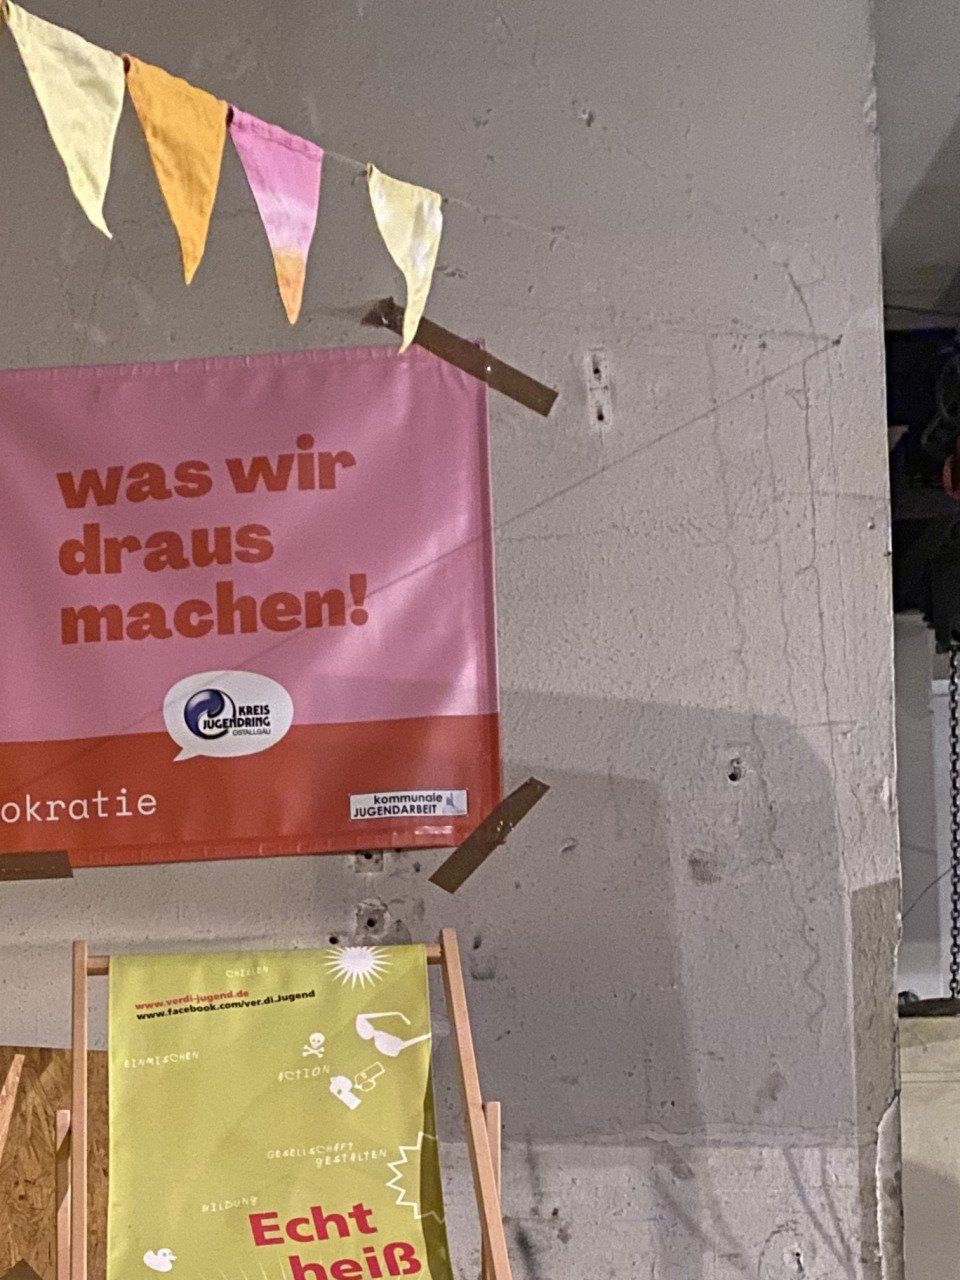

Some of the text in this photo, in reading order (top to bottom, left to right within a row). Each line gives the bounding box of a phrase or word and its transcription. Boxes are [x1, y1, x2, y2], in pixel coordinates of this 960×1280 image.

[56, 433, 356, 509] was wir
[58, 522, 275, 576] draus
[60, 573, 370, 645] machen!
[203, 717, 272, 730] JUGENDRING
[238, 705, 271, 716] KREIS
[353, 804, 437, 818] JUGENDARBEIT
[373, 793, 443, 805] kommunale
[249, 1202, 378, 1246] Echt
